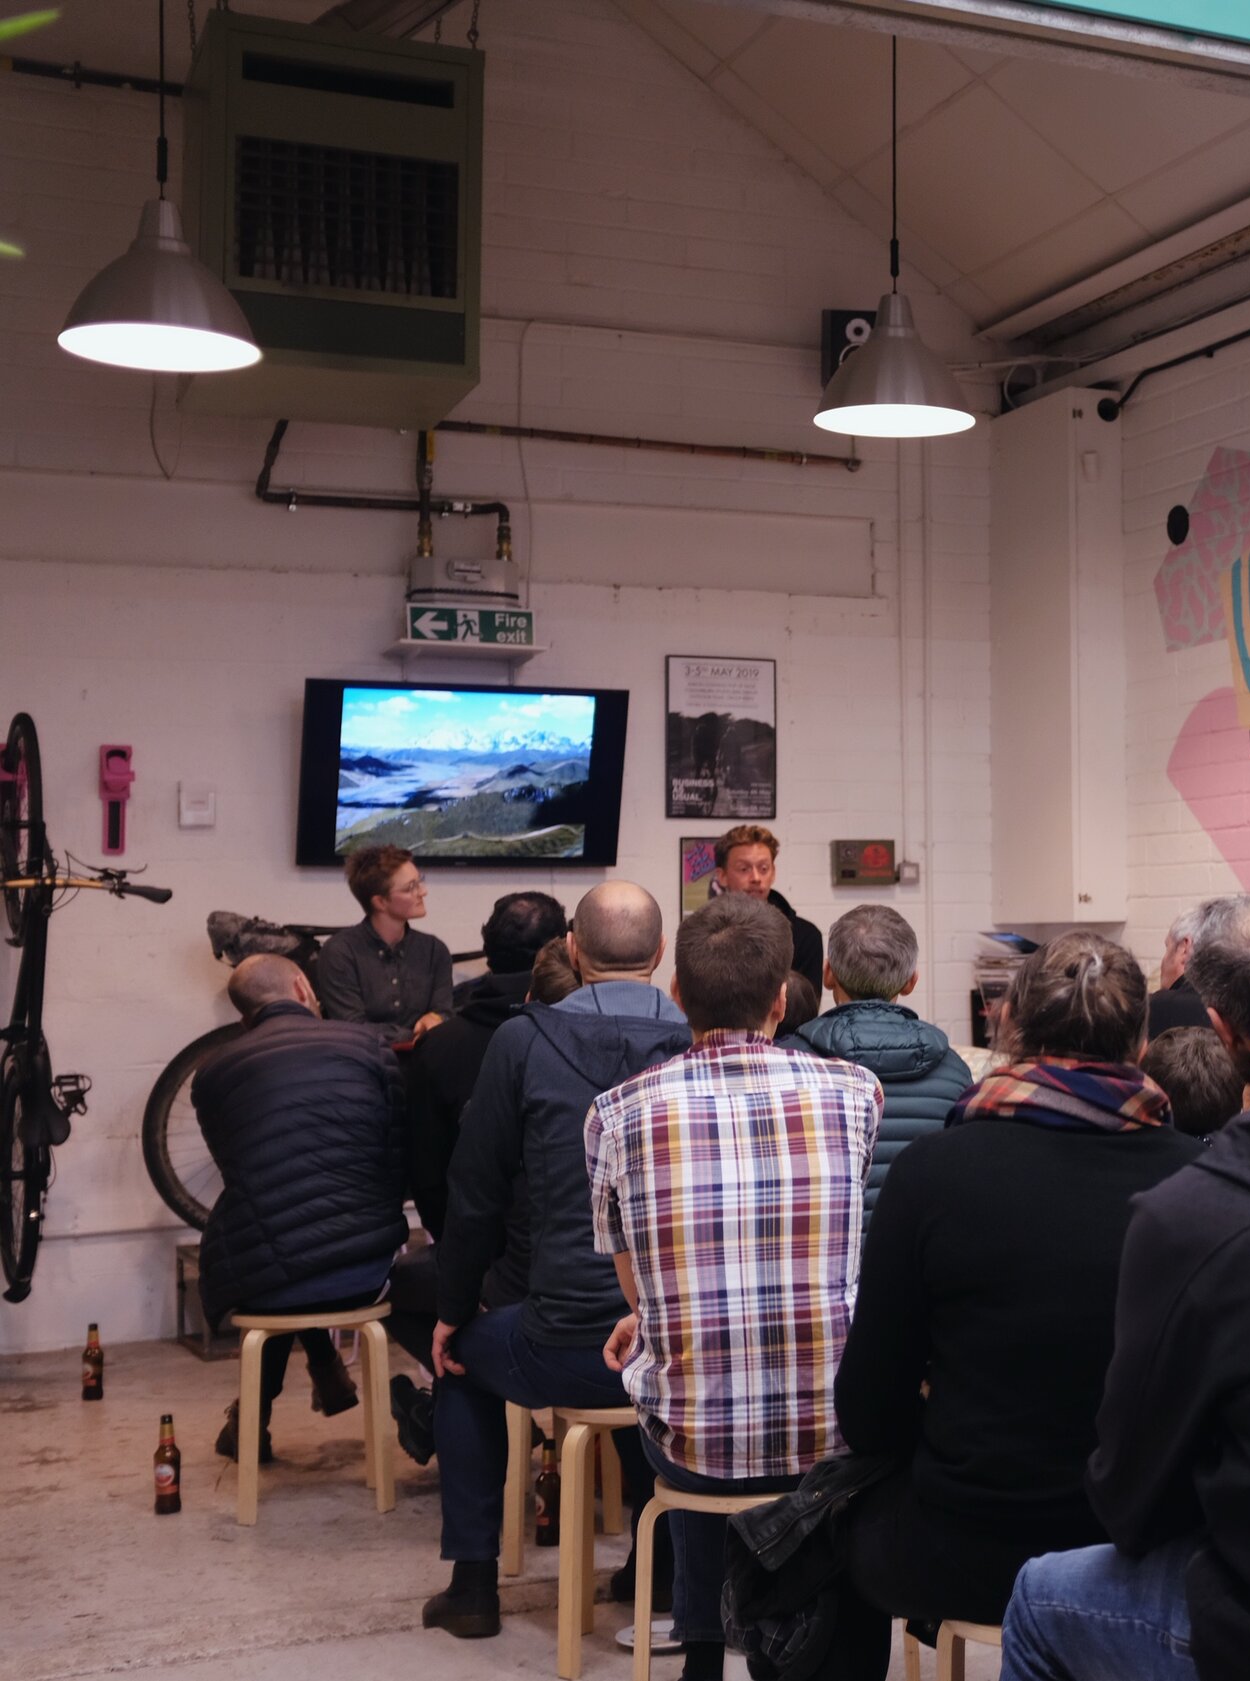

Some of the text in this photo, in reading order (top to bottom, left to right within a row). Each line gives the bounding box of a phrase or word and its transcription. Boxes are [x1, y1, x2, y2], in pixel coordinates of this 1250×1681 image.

[495, 613, 528, 628] Fire
[496, 629, 527, 644] exit
[710, 667, 733, 676] MAY
[736, 668, 760, 678] 2019
[672, 778, 715, 788] BUSINESS
